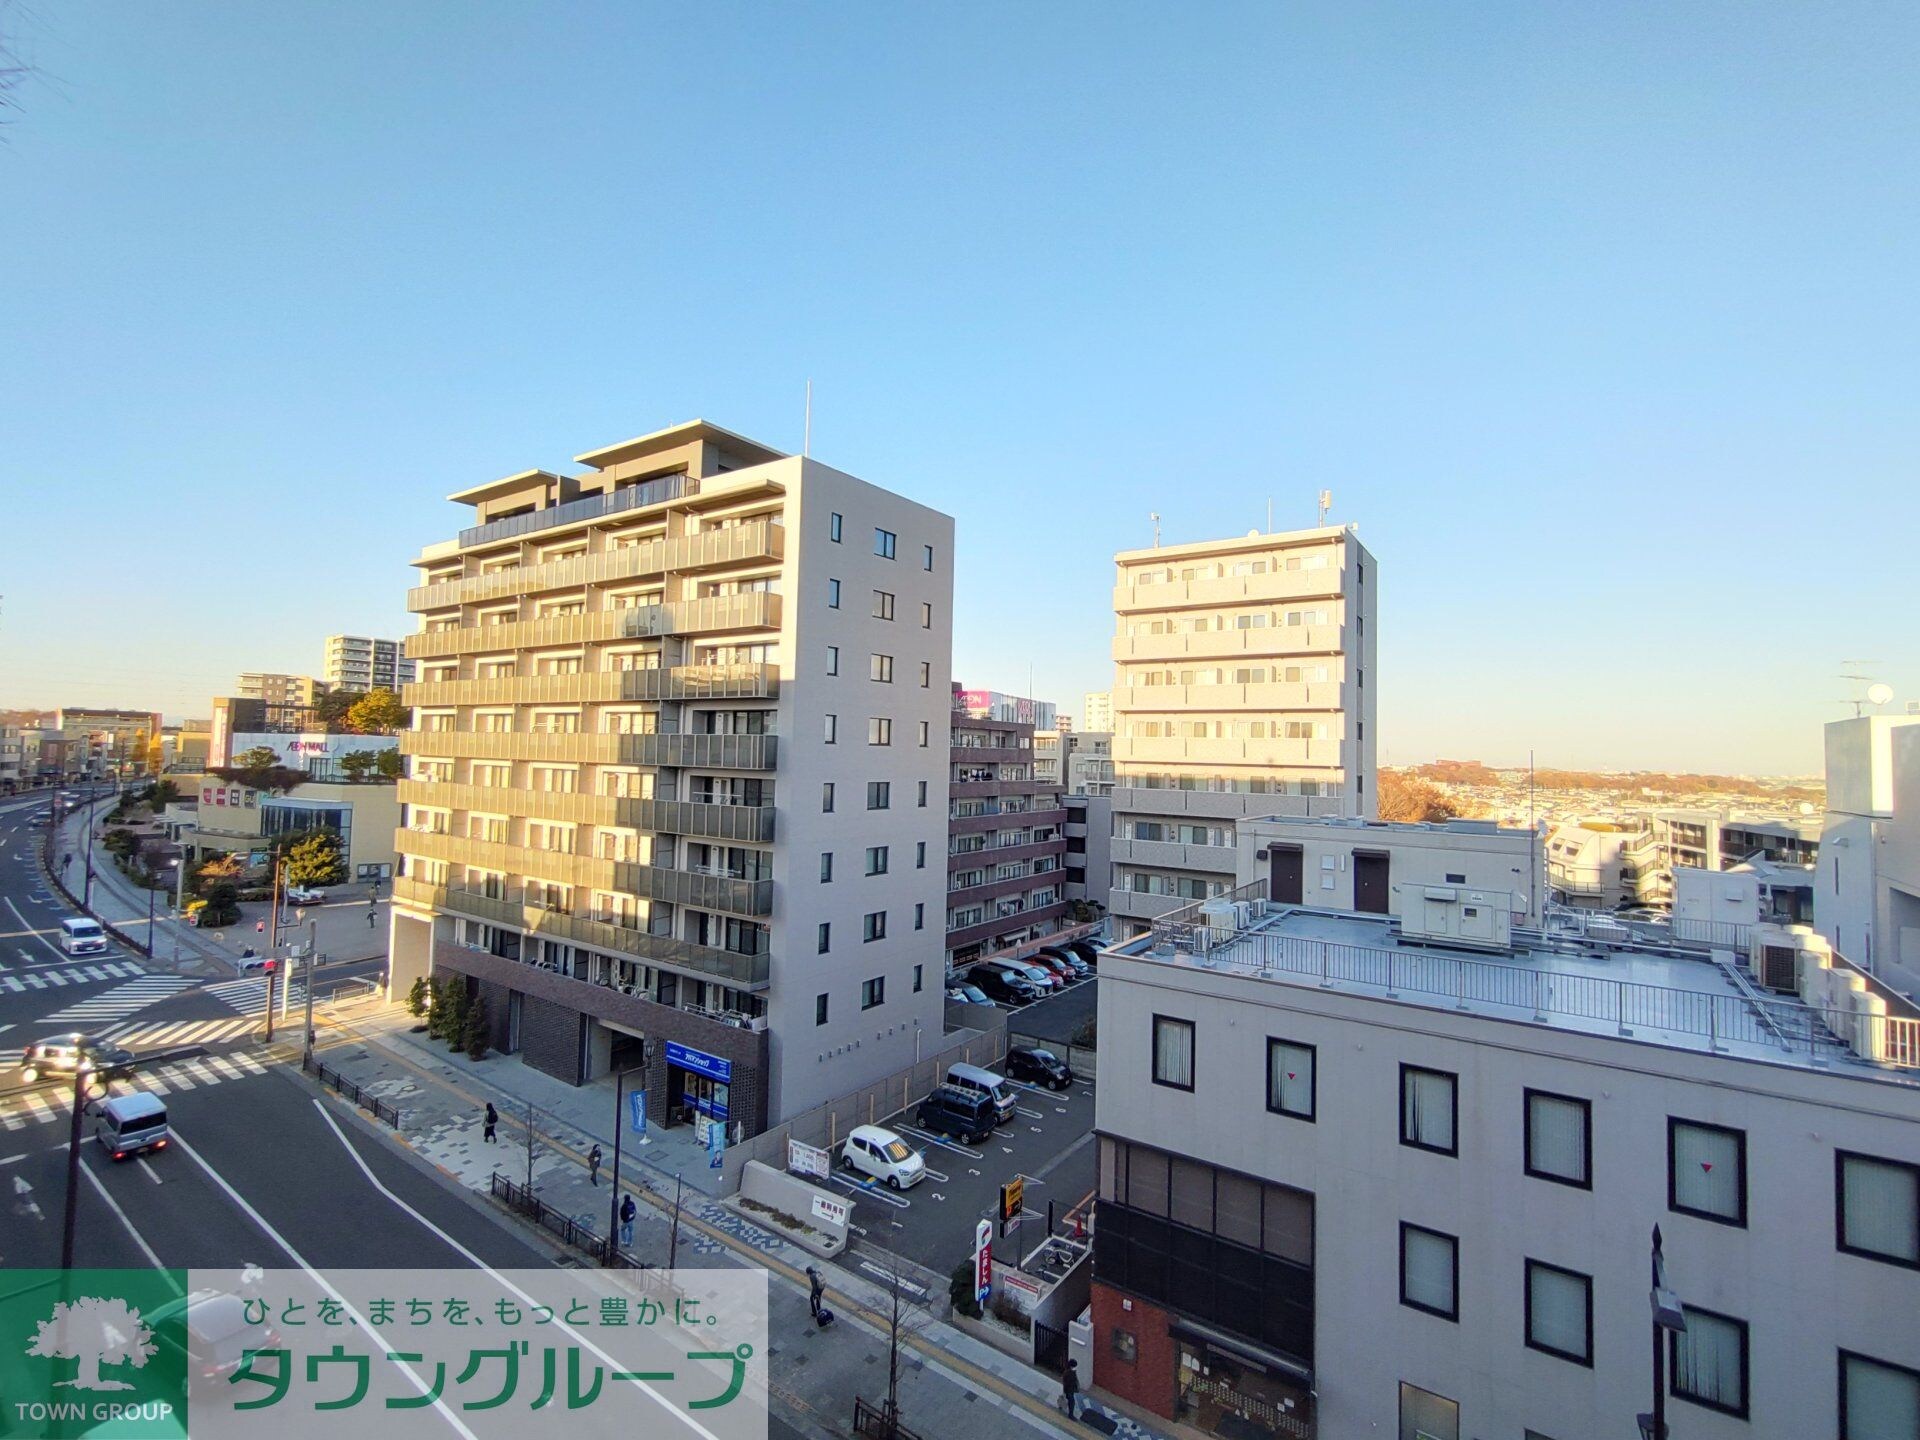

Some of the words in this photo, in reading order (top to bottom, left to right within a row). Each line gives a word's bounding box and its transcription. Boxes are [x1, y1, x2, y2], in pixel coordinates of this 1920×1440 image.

[308, 741, 329, 752] MALL
[1002, 1146, 1013, 1154] 4
[968, 1168, 981, 1176] 3
[932, 1193, 945, 1201] 2
